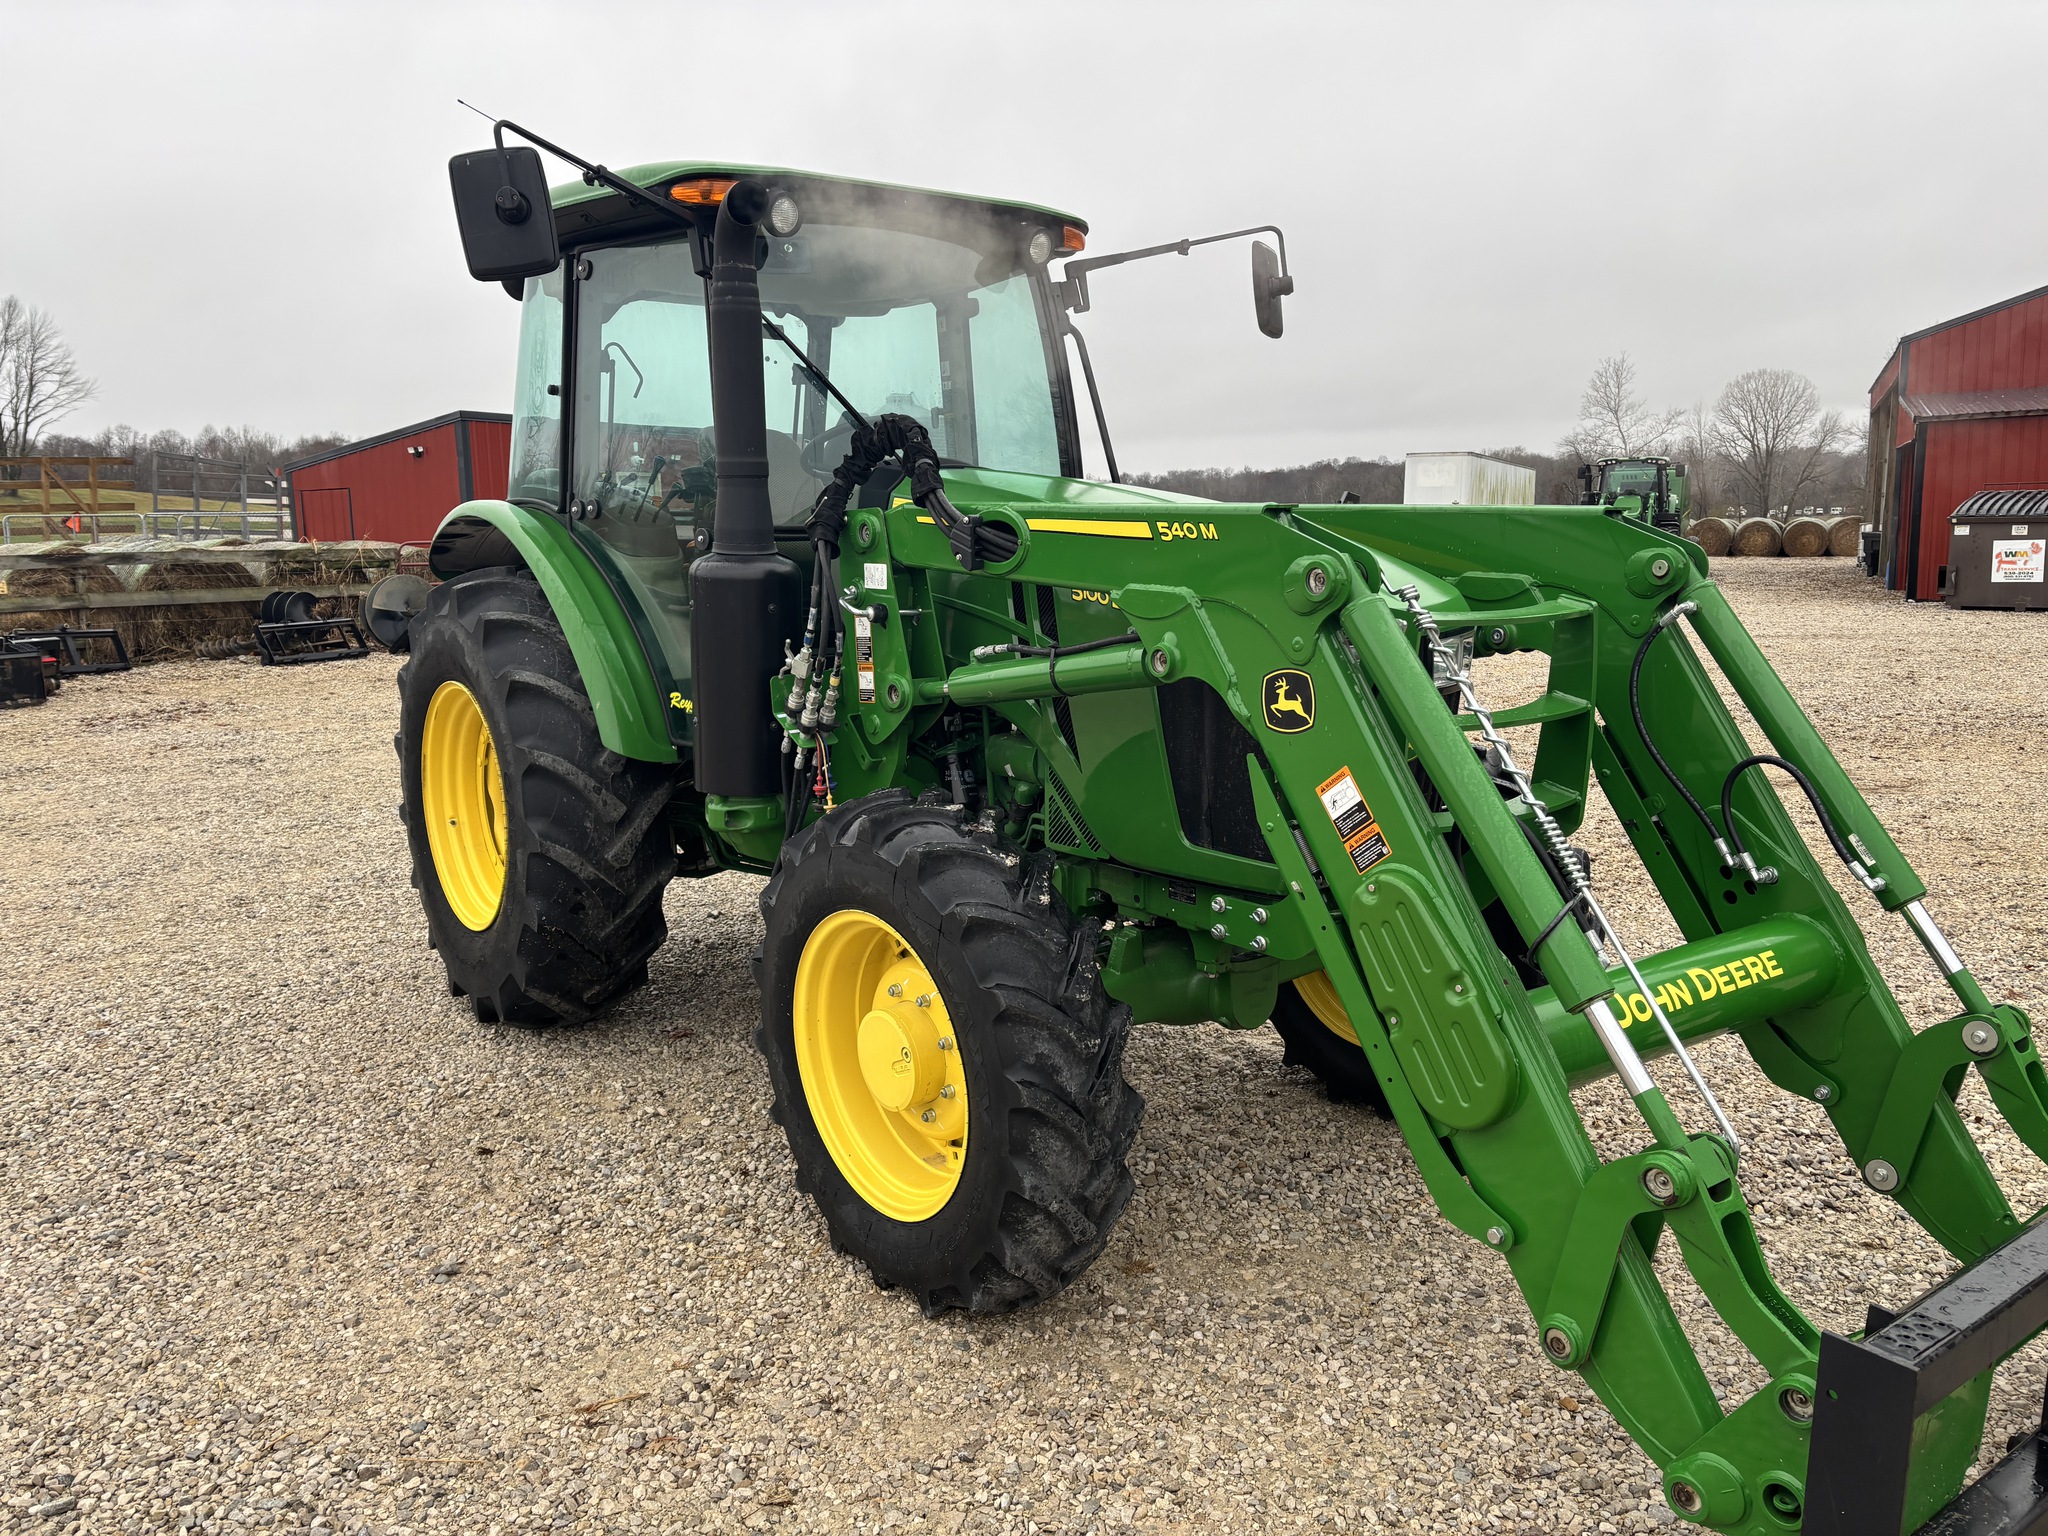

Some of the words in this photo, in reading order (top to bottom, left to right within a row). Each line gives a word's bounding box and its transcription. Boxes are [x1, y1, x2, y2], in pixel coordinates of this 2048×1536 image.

[1071, 588, 1120, 609] 5100
[1325, 771, 1346, 789] WARNING
[1354, 827, 1376, 845] WARNING
[1613, 979, 1694, 1029] JOHN
[1685, 950, 1784, 1001] DEERE
